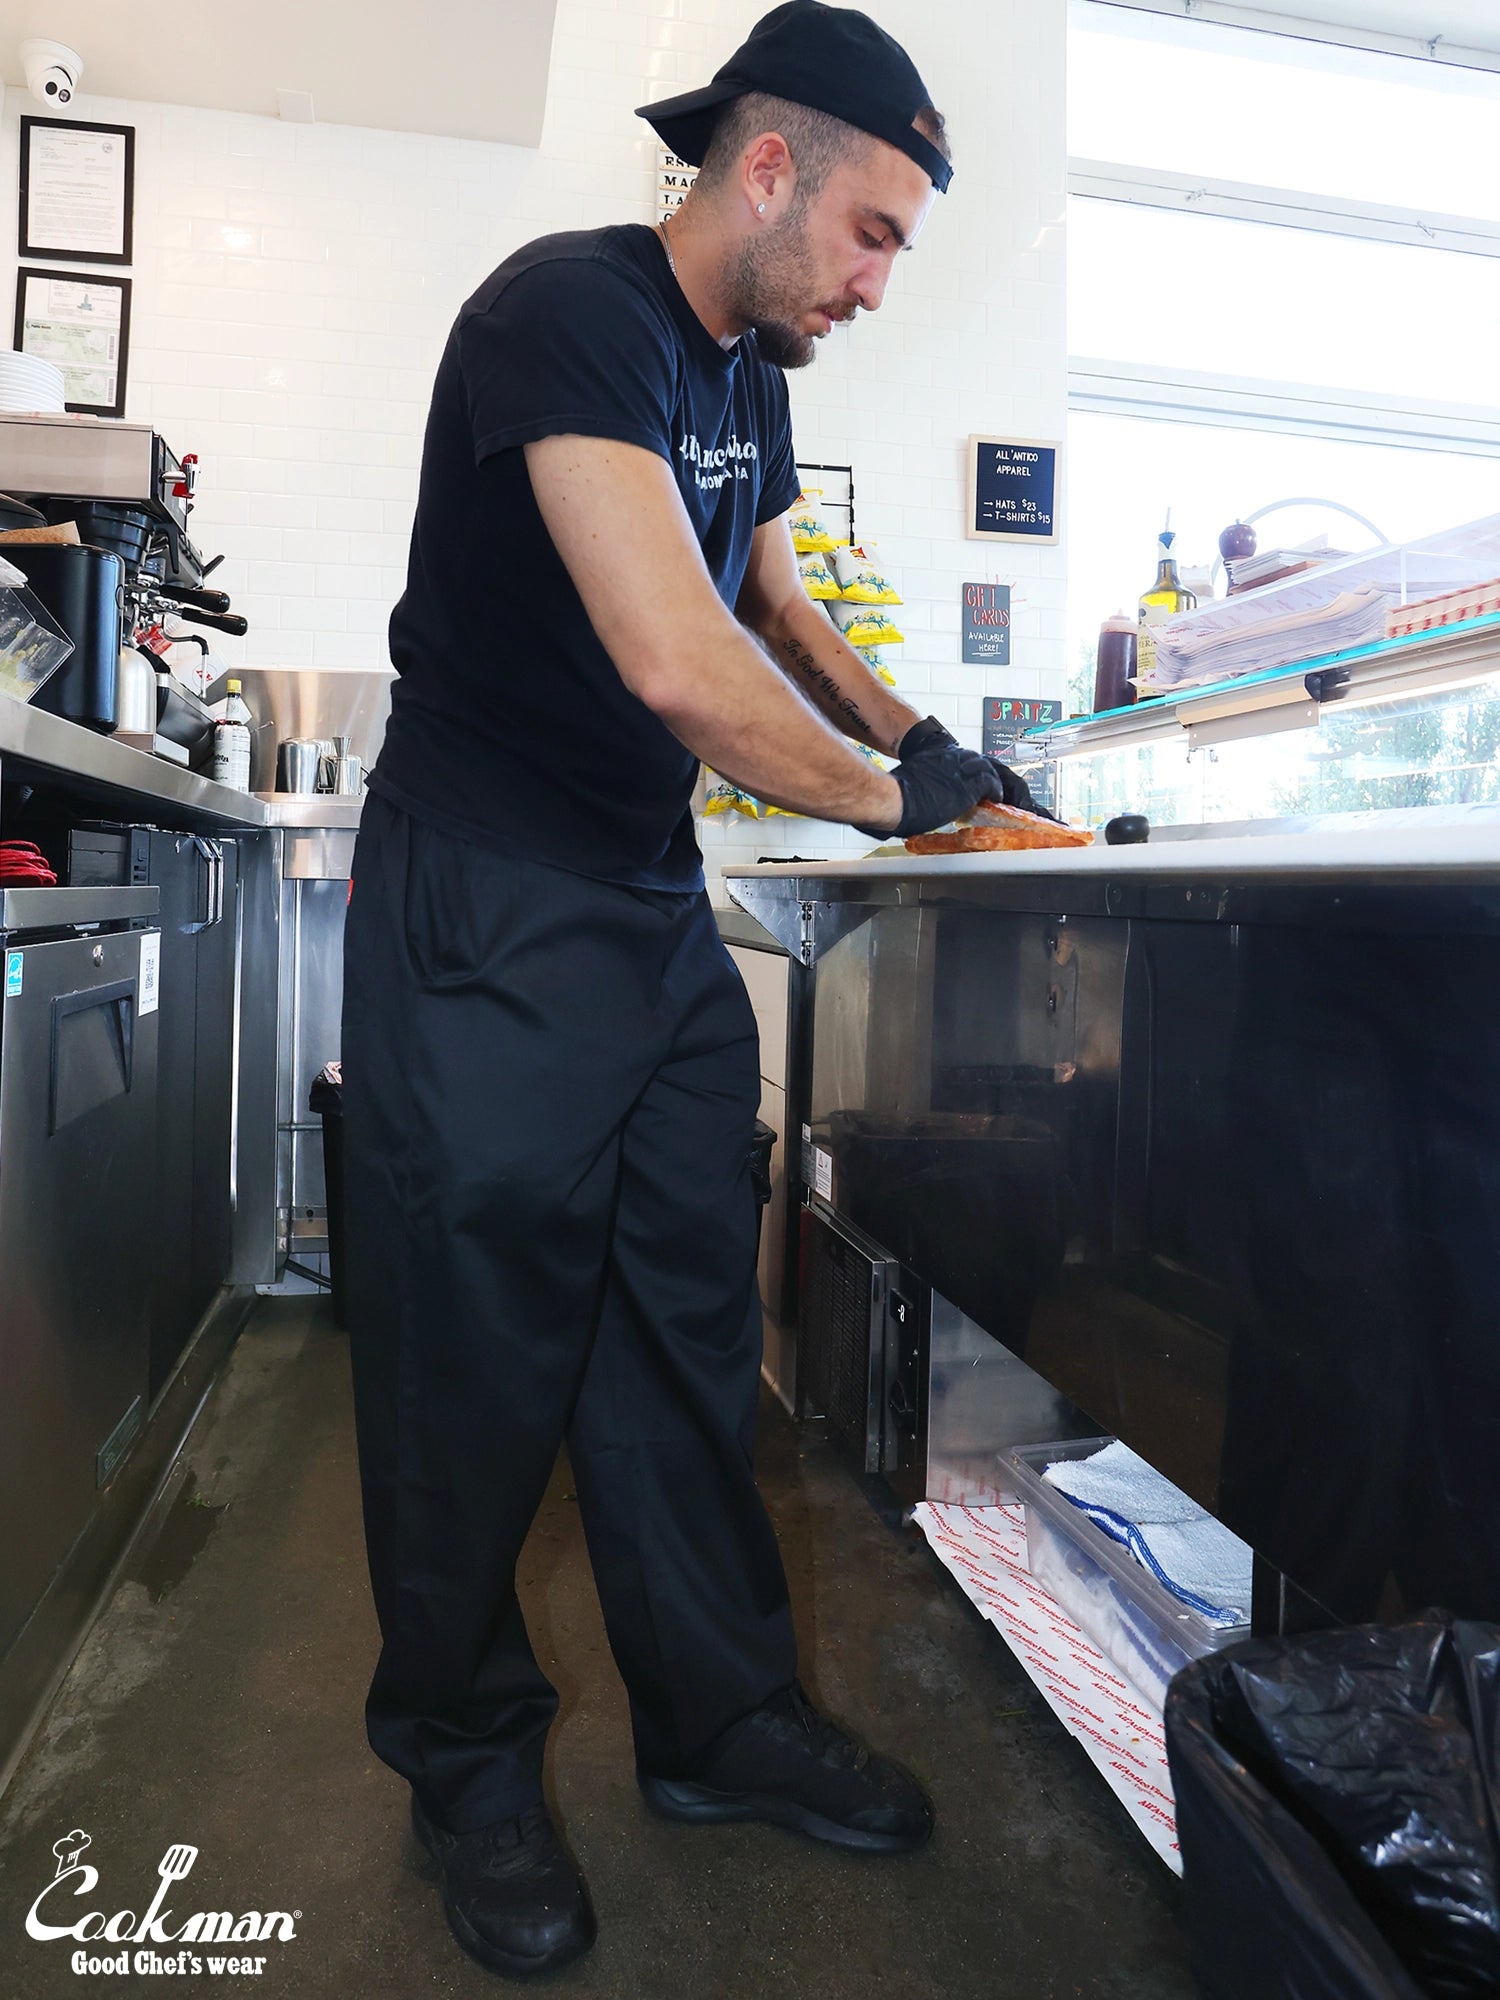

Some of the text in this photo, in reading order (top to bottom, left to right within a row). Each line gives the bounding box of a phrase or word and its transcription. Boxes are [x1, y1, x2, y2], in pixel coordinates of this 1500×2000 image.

[996, 464, 1031, 477] APPAREL
[995, 498, 1037, 512] HATS $23
[994, 510, 1051, 524] T-SHIRTS $15
[965, 585, 997, 608] GIFT
[972, 608, 1010, 628] CARDS
[968, 631, 1005, 643] AVAILABLE
[978, 643, 999, 653] HERE!
[783, 639, 871, 734] In God We Trust
[990, 700, 1053, 723] SPRITZ
